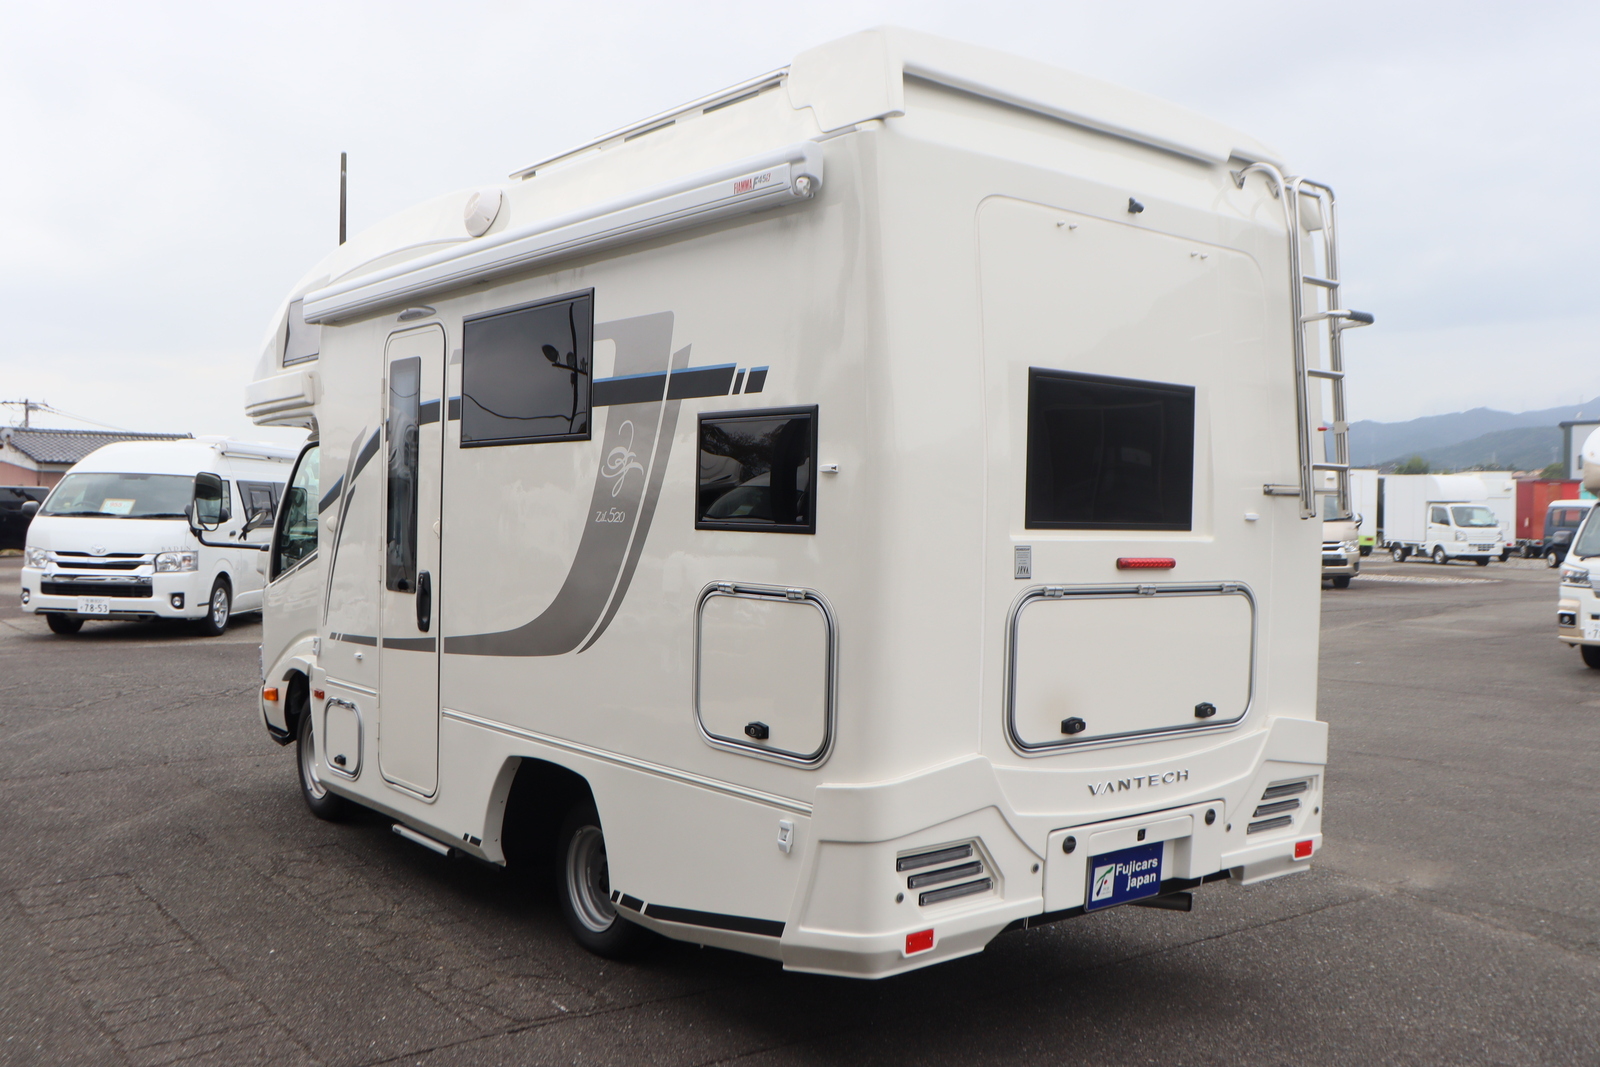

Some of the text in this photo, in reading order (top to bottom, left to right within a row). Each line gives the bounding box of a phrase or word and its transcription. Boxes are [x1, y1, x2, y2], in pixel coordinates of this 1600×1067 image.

[733, 178, 752, 195] FIAMMA
[607, 507, 626, 523] 520
[84, 603, 108, 613] 78-53
[1087, 768, 1189, 796] VANTECH
[1115, 857, 1159, 877] Fujicars
[1125, 872, 1157, 892] japan
